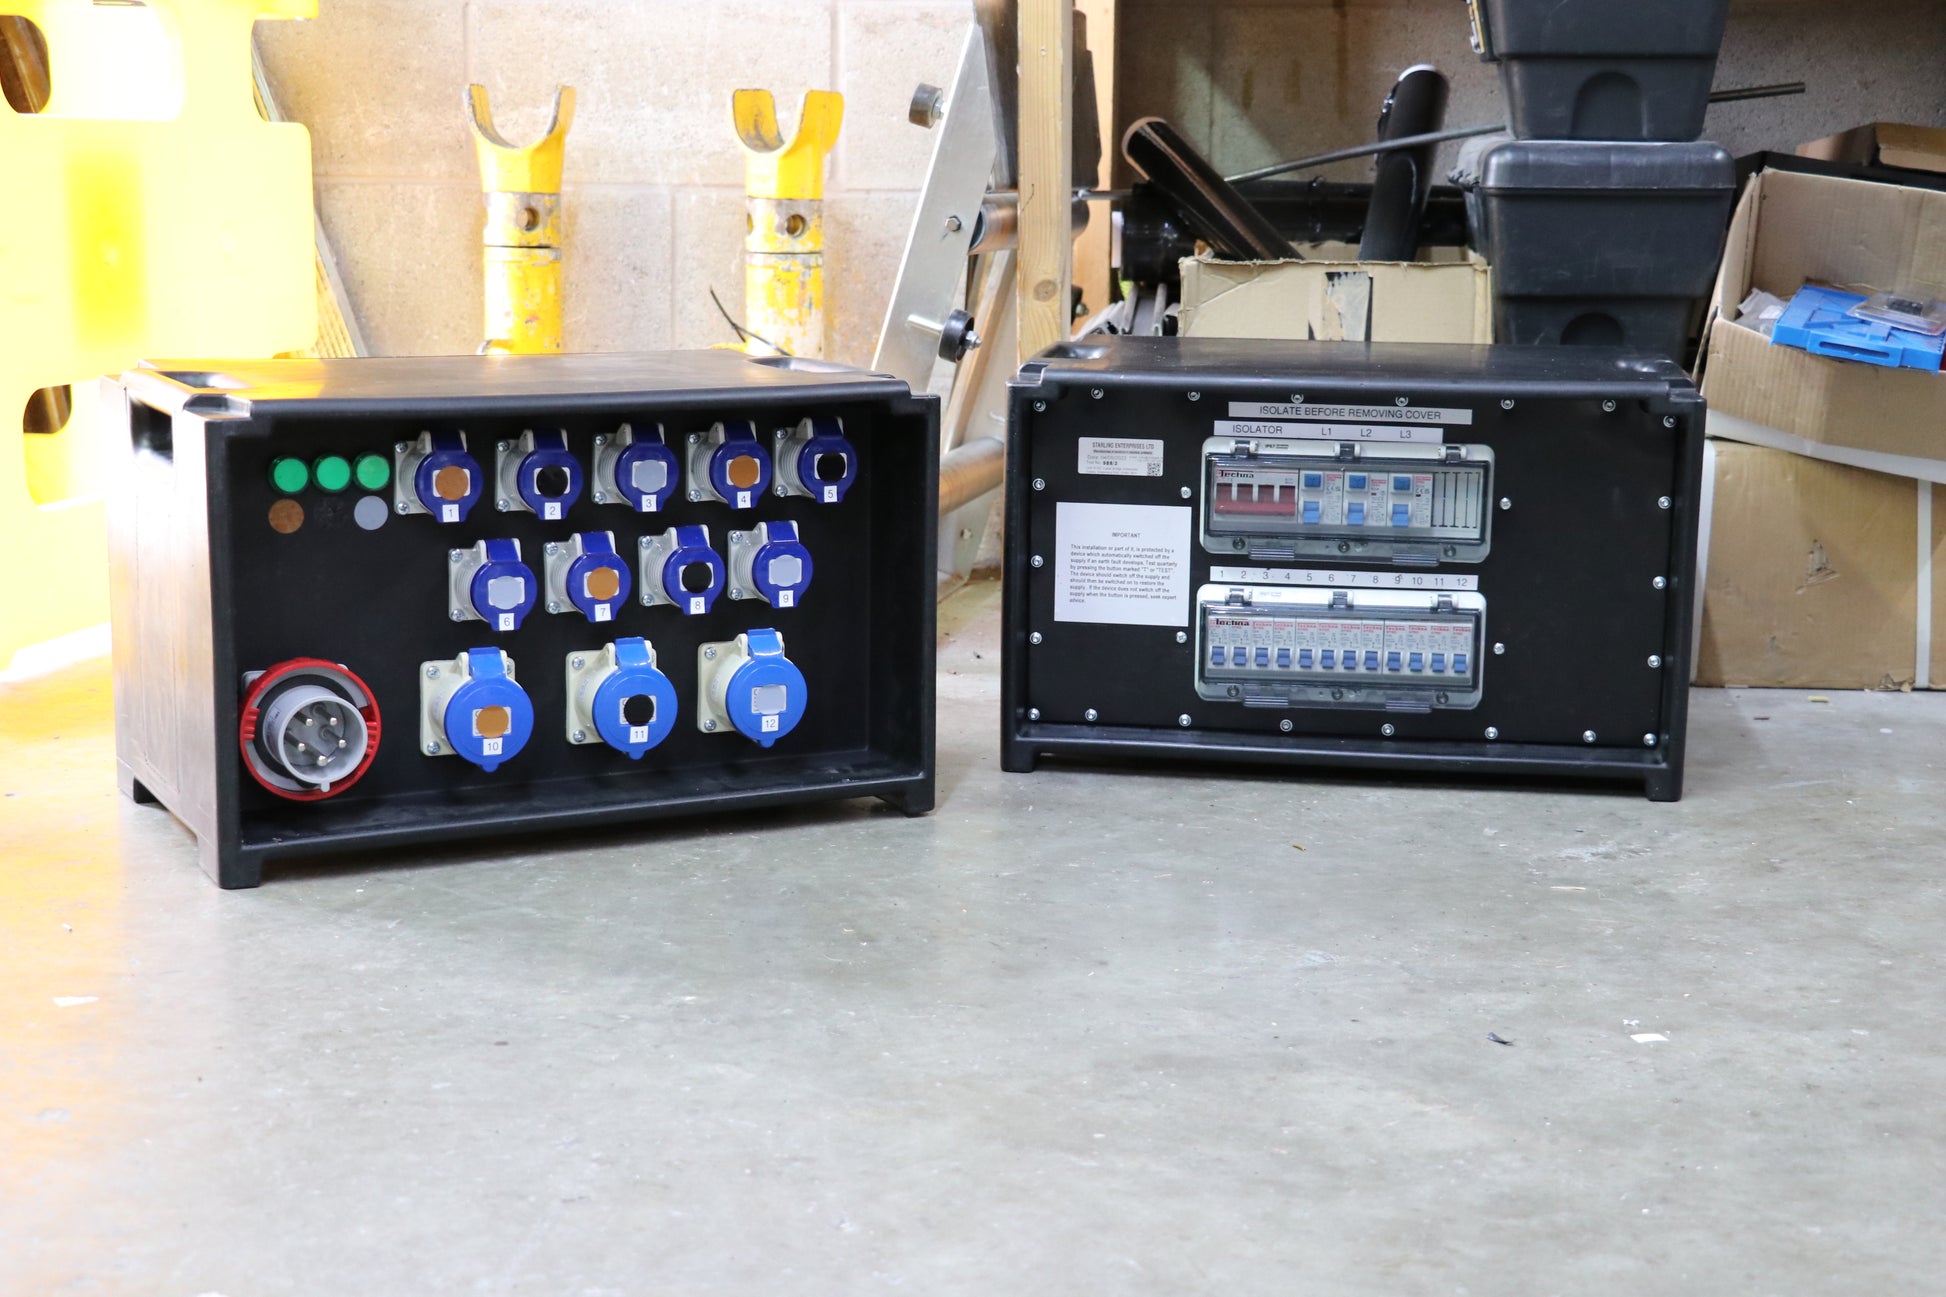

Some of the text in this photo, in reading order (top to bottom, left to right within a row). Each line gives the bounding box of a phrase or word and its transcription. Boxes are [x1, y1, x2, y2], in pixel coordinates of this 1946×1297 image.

[1260, 406, 1442, 420] ISOLATE BEFORE REMOVING COVER
[1232, 424, 1412, 439] ISOLATOR L1 L2 L3
[740, 494, 746, 504] 4
[828, 490, 834, 498] 5
[646, 498, 652, 508] 3
[549, 506, 556, 516] 2
[1240, 570, 1247, 579] 2
[1262, 571, 1269, 580] 3
[1284, 572, 1291, 580] 4
[1306, 572, 1312, 581] 5
[1328, 574, 1334, 582] 6
[1350, 574, 1356, 582] 7
[1372, 575, 1378, 584] 8
[1394, 576, 1400, 584] 9
[1412, 576, 1423, 585] 10
[1434, 578, 1444, 586] 11
[1456, 578, 1468, 586] 12
[782, 594, 788, 604] 9
[694, 600, 701, 610] 8
[600, 607, 606, 616] 7
[504, 616, 510, 626] 6
[766, 718, 776, 728] 12
[634, 730, 644, 740] 11
[488, 742, 499, 752] 10
